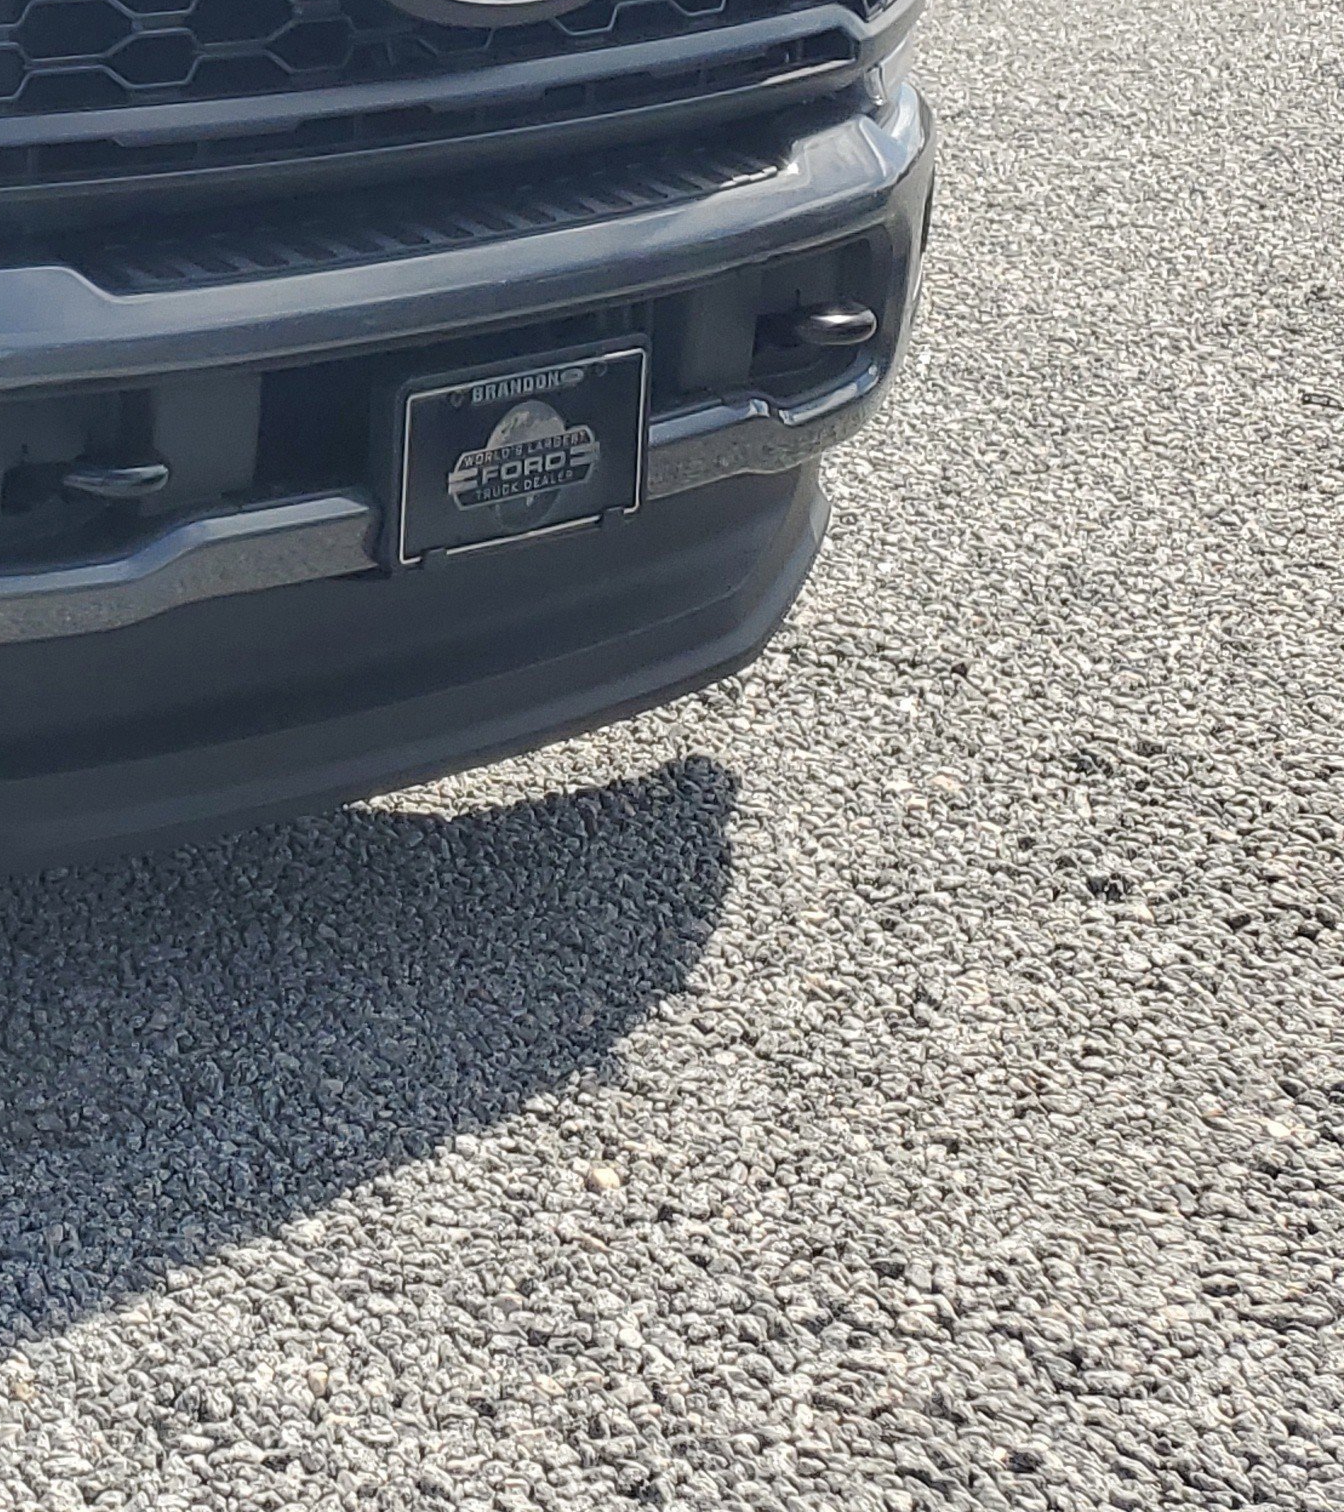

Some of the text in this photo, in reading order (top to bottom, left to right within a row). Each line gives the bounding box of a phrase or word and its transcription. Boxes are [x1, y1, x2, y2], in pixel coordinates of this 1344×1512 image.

[472, 370, 560, 403] BRANDON
[481, 450, 566, 485] FORD
[475, 481, 518, 501] TRUCK
